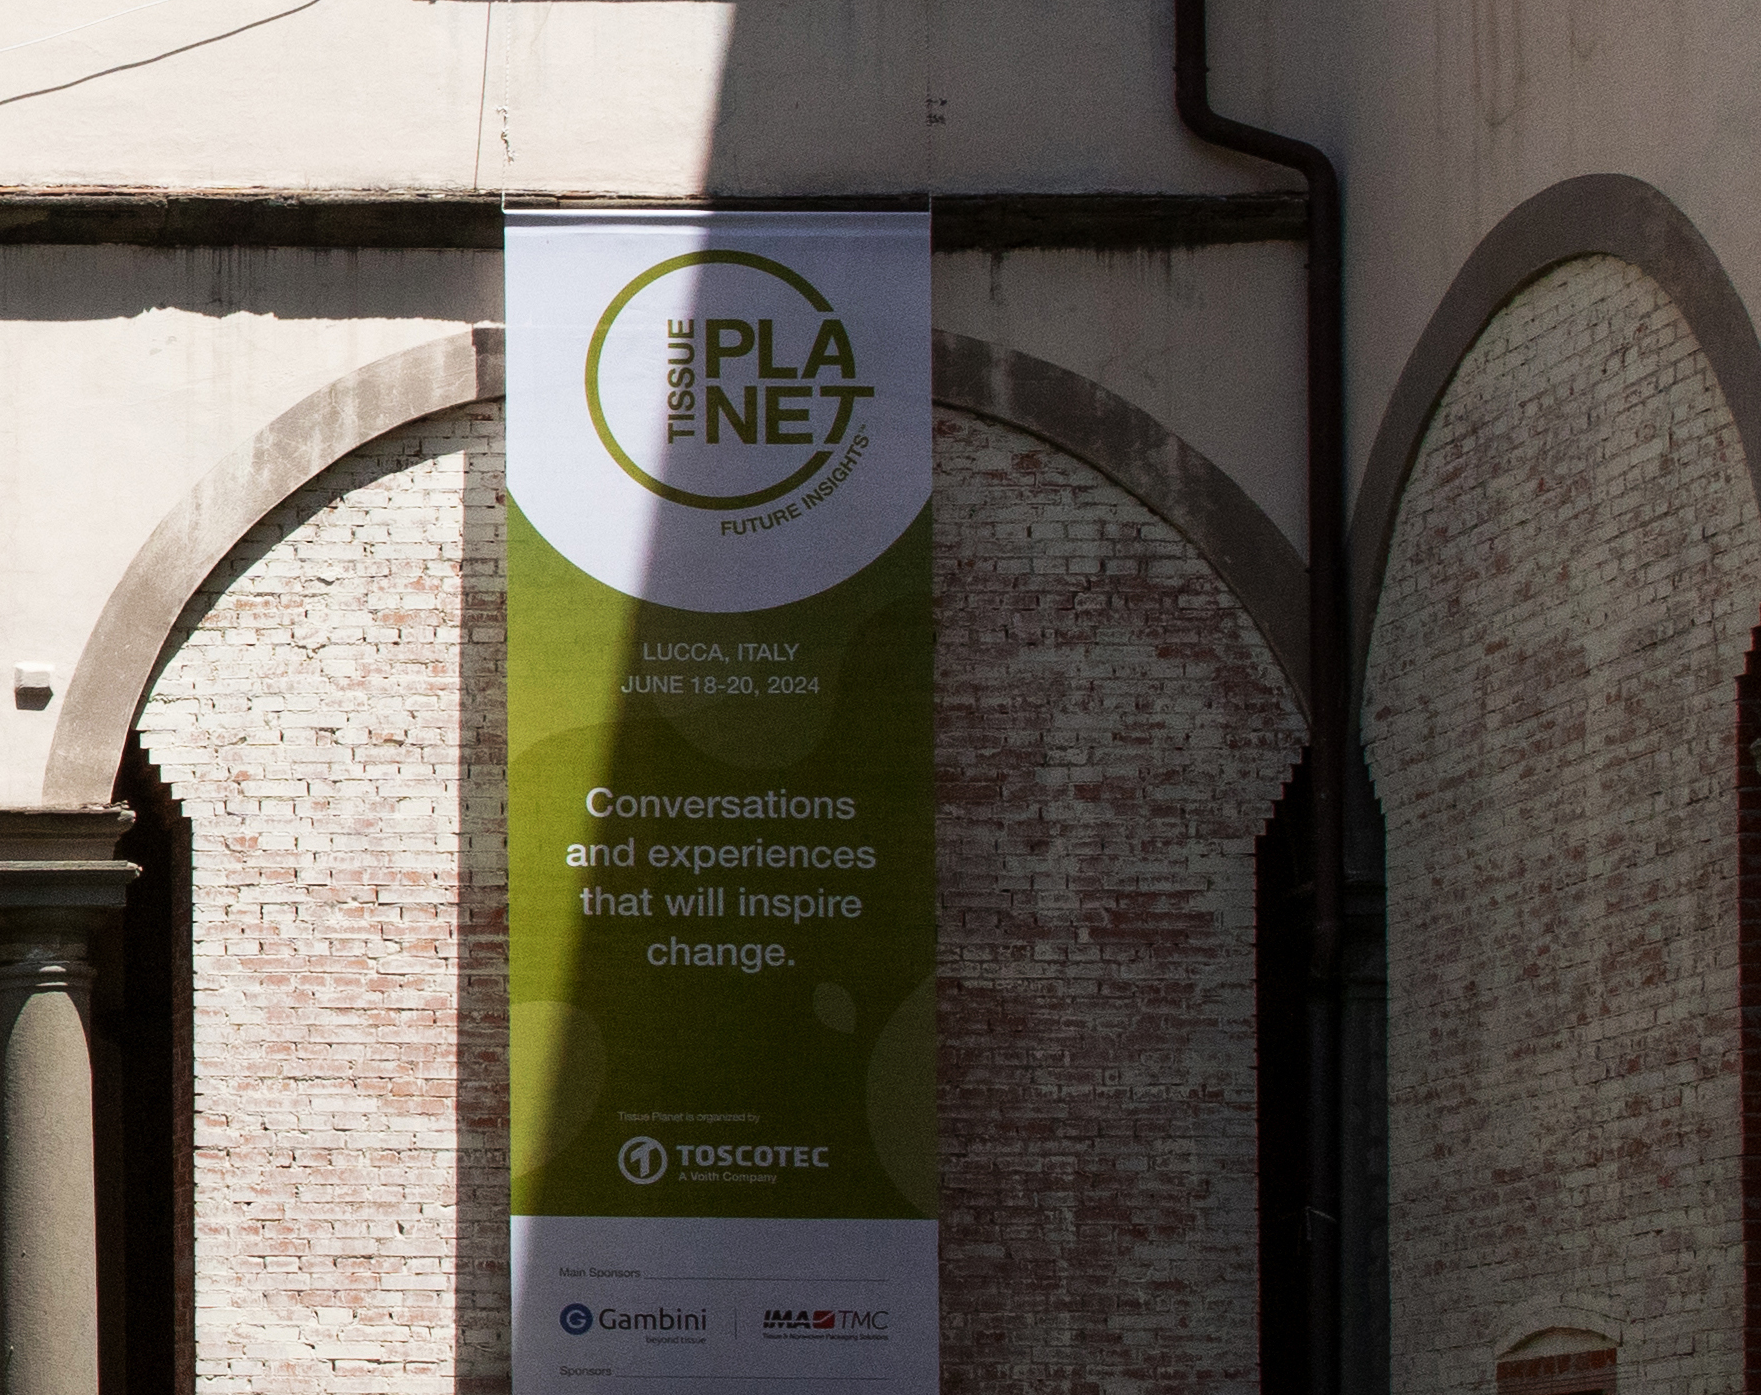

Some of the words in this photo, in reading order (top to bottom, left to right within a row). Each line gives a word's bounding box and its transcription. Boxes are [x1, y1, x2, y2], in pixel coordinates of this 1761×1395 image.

[705, 318, 856, 379] PLA
[667, 318, 695, 444] TISSUE
[705, 385, 875, 445] NET
[720, 503, 802, 536] FUTURE
[642, 643, 730, 664] LUCCA,
[738, 643, 800, 661] ITALY
[621, 675, 684, 694] JUNE
[691, 676, 759, 697] 18-20,
[767, 676, 820, 694] 2024
[585, 787, 856, 820] Conversations
[566, 838, 635, 868] and
[648, 838, 876, 875] experiences
[579, 887, 653, 917] that
[665, 887, 724, 917] will
[738, 887, 862, 925] inspire
[647, 937, 796, 973] change.
[618, 1112, 649, 1122] Tissue
[652, 1112, 684, 1122] Planet
[685, 1112, 694, 1122] is
[697, 1112, 746, 1124] organized
[747, 1112, 760, 1124] by
[676, 1145, 829, 1168] TOSCOTEC
[679, 1172, 687, 1181] A
[691, 1171, 719, 1181] Voith
[723, 1171, 777, 1184] Company
[559, 1267, 586, 1277] Main
[589, 1267, 641, 1279] Sponsors
[599, 1307, 706, 1330] Gambini
[763, 1310, 811, 1329] IMA
[838, 1310, 889, 1330] TMC
[646, 1336, 679, 1346] beyond
[559, 1366, 612, 1377] Sponsors
